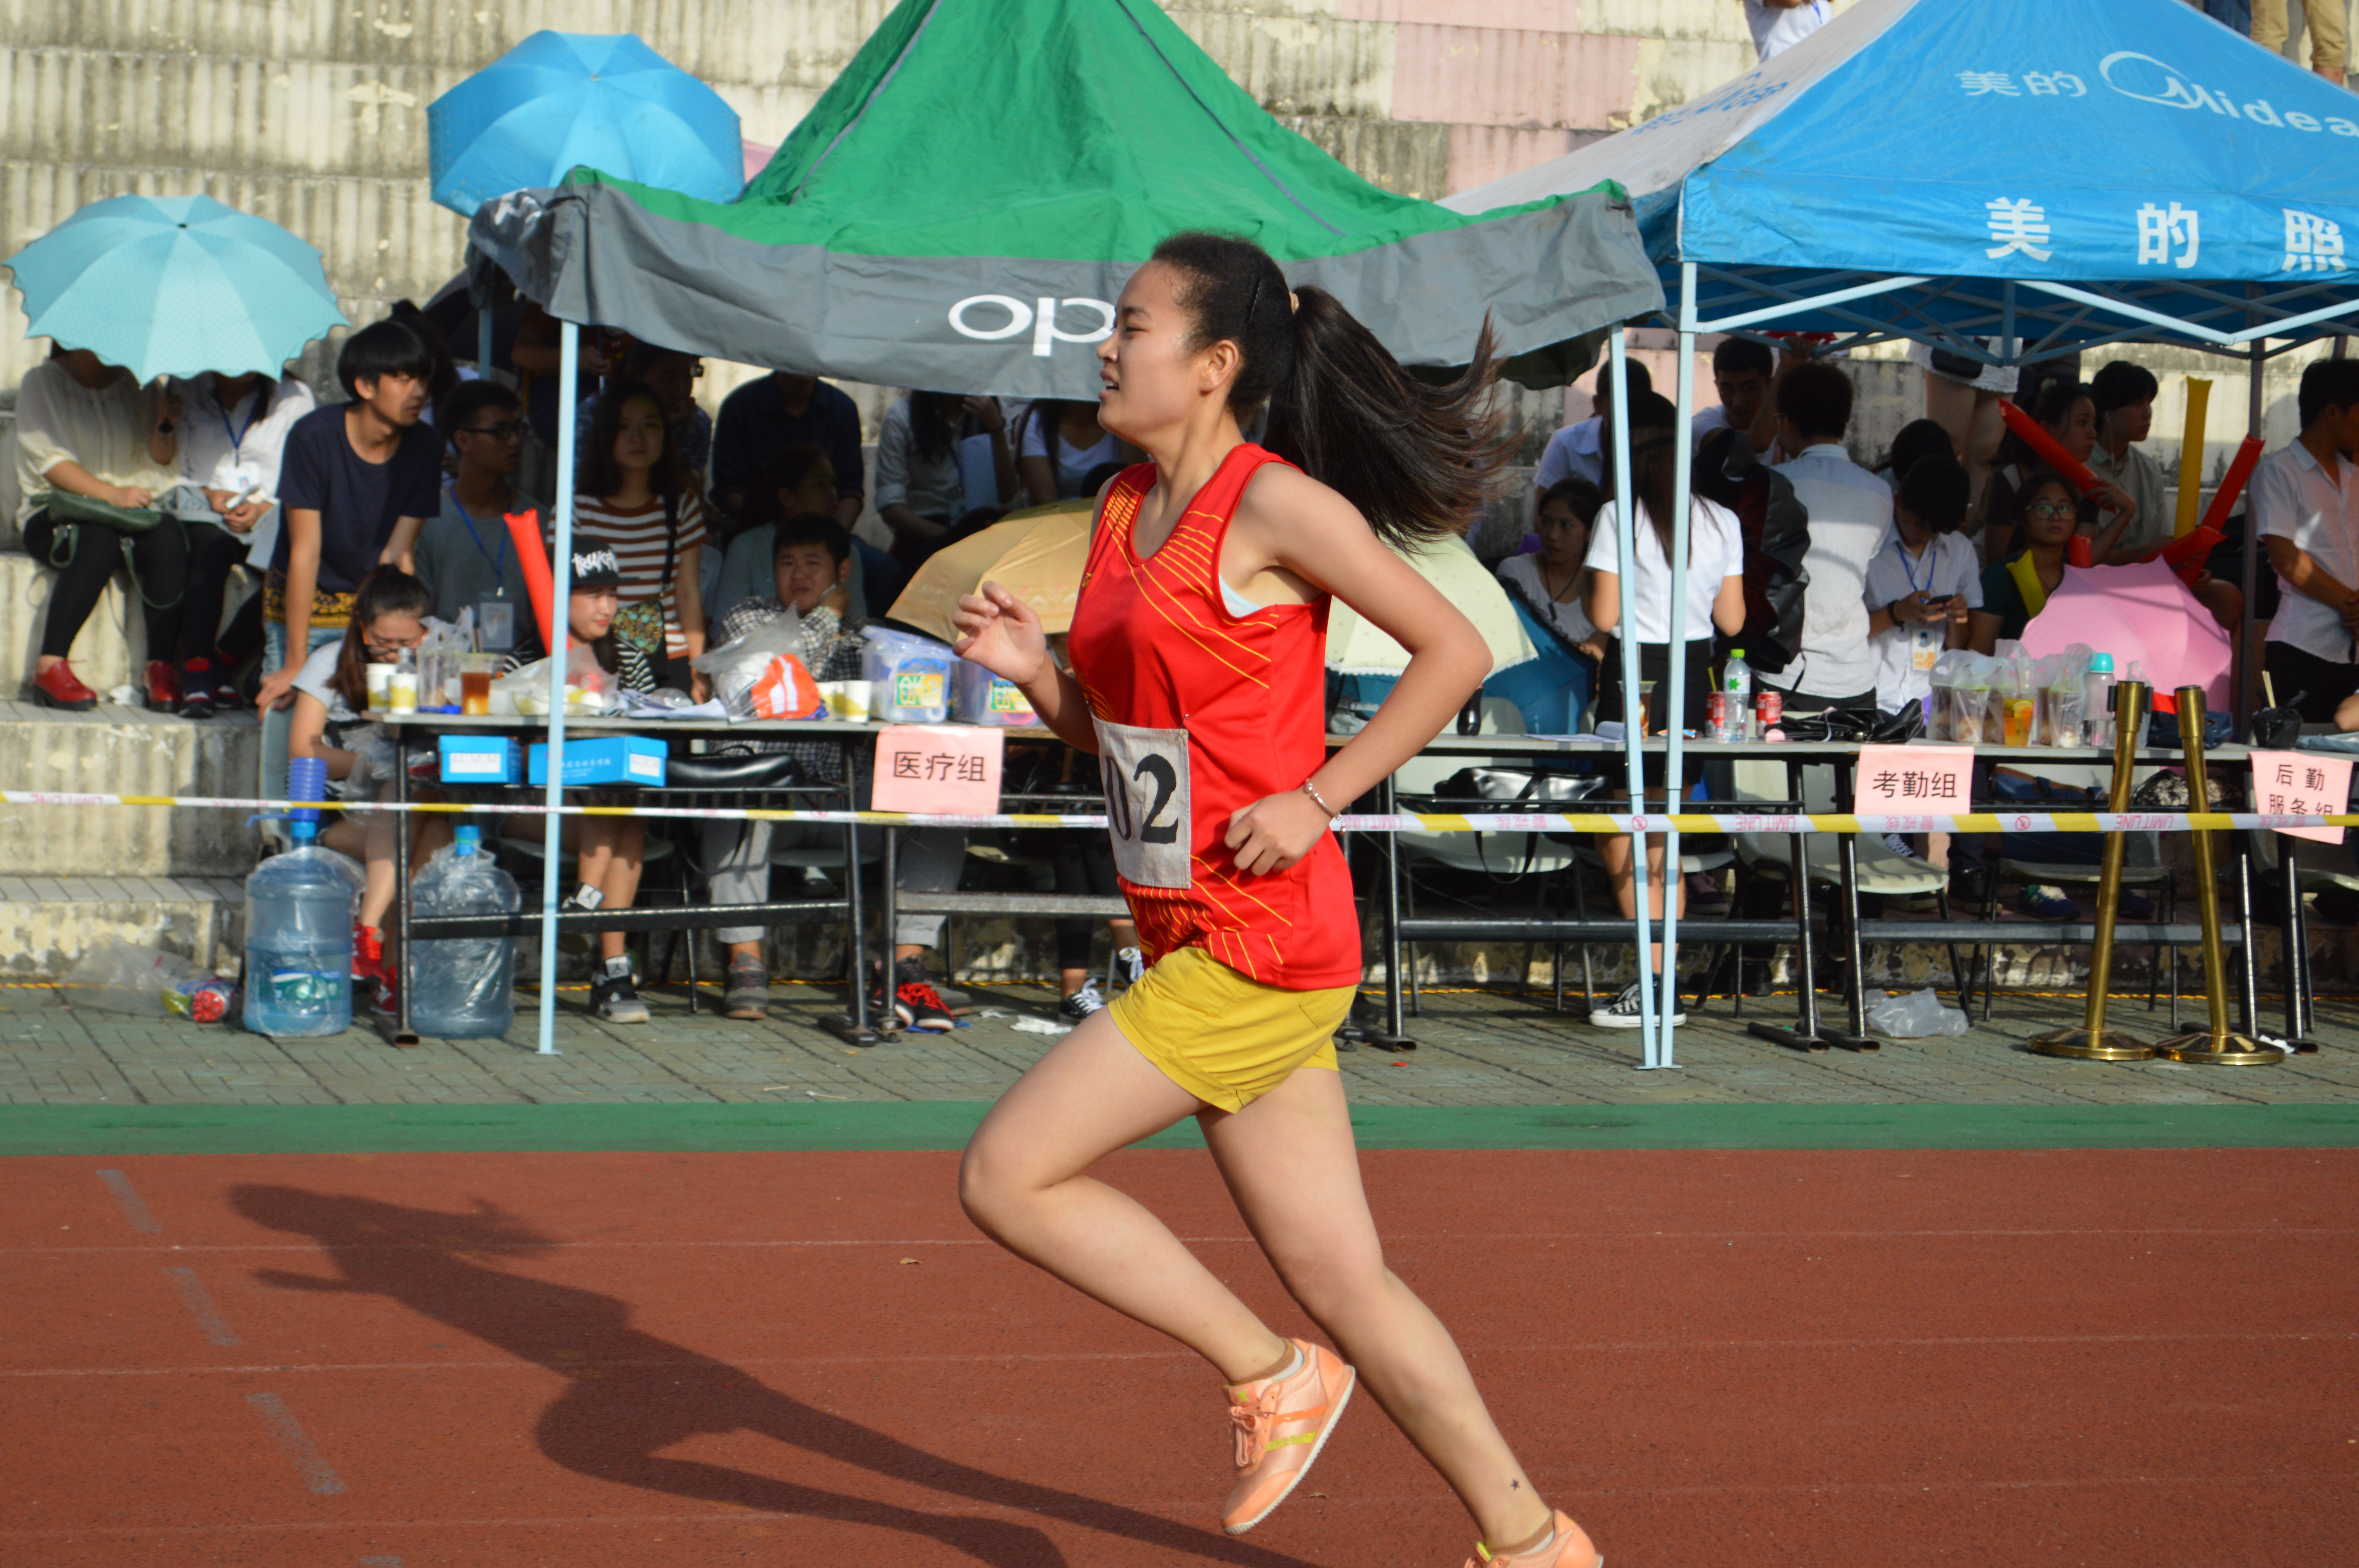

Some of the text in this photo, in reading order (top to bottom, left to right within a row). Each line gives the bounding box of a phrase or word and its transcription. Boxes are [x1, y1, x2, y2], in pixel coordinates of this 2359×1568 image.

[1955, 71, 2359, 136] 美的 Midea
[893, 751, 986, 782] 医疗组
[2275, 764, 2324, 791] 后勤
[1106, 753, 1179, 844] 02
[1872, 770, 1957, 799] 考勤组
[1735, 815, 1796, 831] LIMIT LINE
[1885, 816, 1934, 831] 警戒线
[2113, 815, 2174, 829] LIMIT LINE
